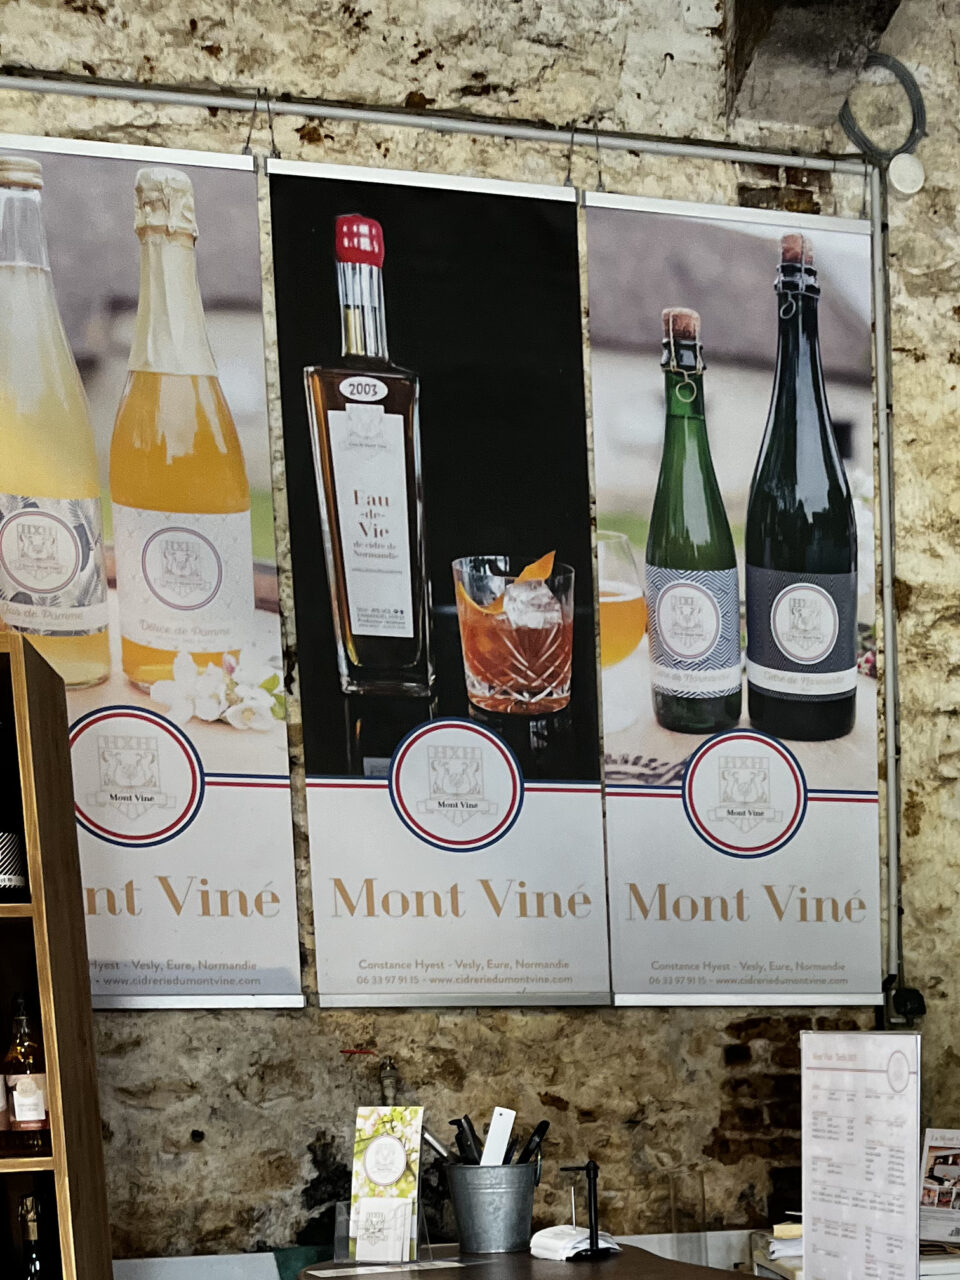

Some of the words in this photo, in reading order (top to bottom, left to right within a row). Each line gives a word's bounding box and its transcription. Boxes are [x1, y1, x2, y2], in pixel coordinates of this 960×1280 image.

[348, 383, 378, 396] 2003
[359, 521, 390, 538] Vie
[109, 792, 133, 803] Mont
[437, 800, 459, 809] Mont
[726, 808, 747, 817] Mont
[84, 878, 143, 917] nt
[154, 875, 282, 918] Viné
[329, 876, 467, 919] Mont
[476, 878, 593, 920] Viné
[624, 882, 750, 922] Mont
[761, 884, 868, 924] Viné
[131, 960, 164, 973] Vesly,
[166, 959, 195, 972] Eure,
[198, 960, 258, 971] Normandie
[358, 959, 412, 971] Constance
[415, 959, 445, 973] Hyest
[455, 959, 485, 972] Vesly,
[487, 959, 513, 972] Eure,
[515, 959, 570, 970] Normandie
[651, 960, 700, 972] Constance
[702, 960, 731, 974] Hyest
[769, 960, 794, 973] Eure,
[795, 961, 846, 972] Normandie
[103, 974, 262, 986] www.cidreriedumontvine.com
[356, 974, 370, 985] 06
[384, 974, 398, 985] 97
[399, 974, 408, 985] 91
[409, 974, 420, 985] 15
[429, 973, 574, 985] www.cidreriedumontvine.com
[648, 975, 662, 986] 06
[674, 975, 687, 986] 97
[715, 974, 849, 987] www.cidreriedumontvine.com
